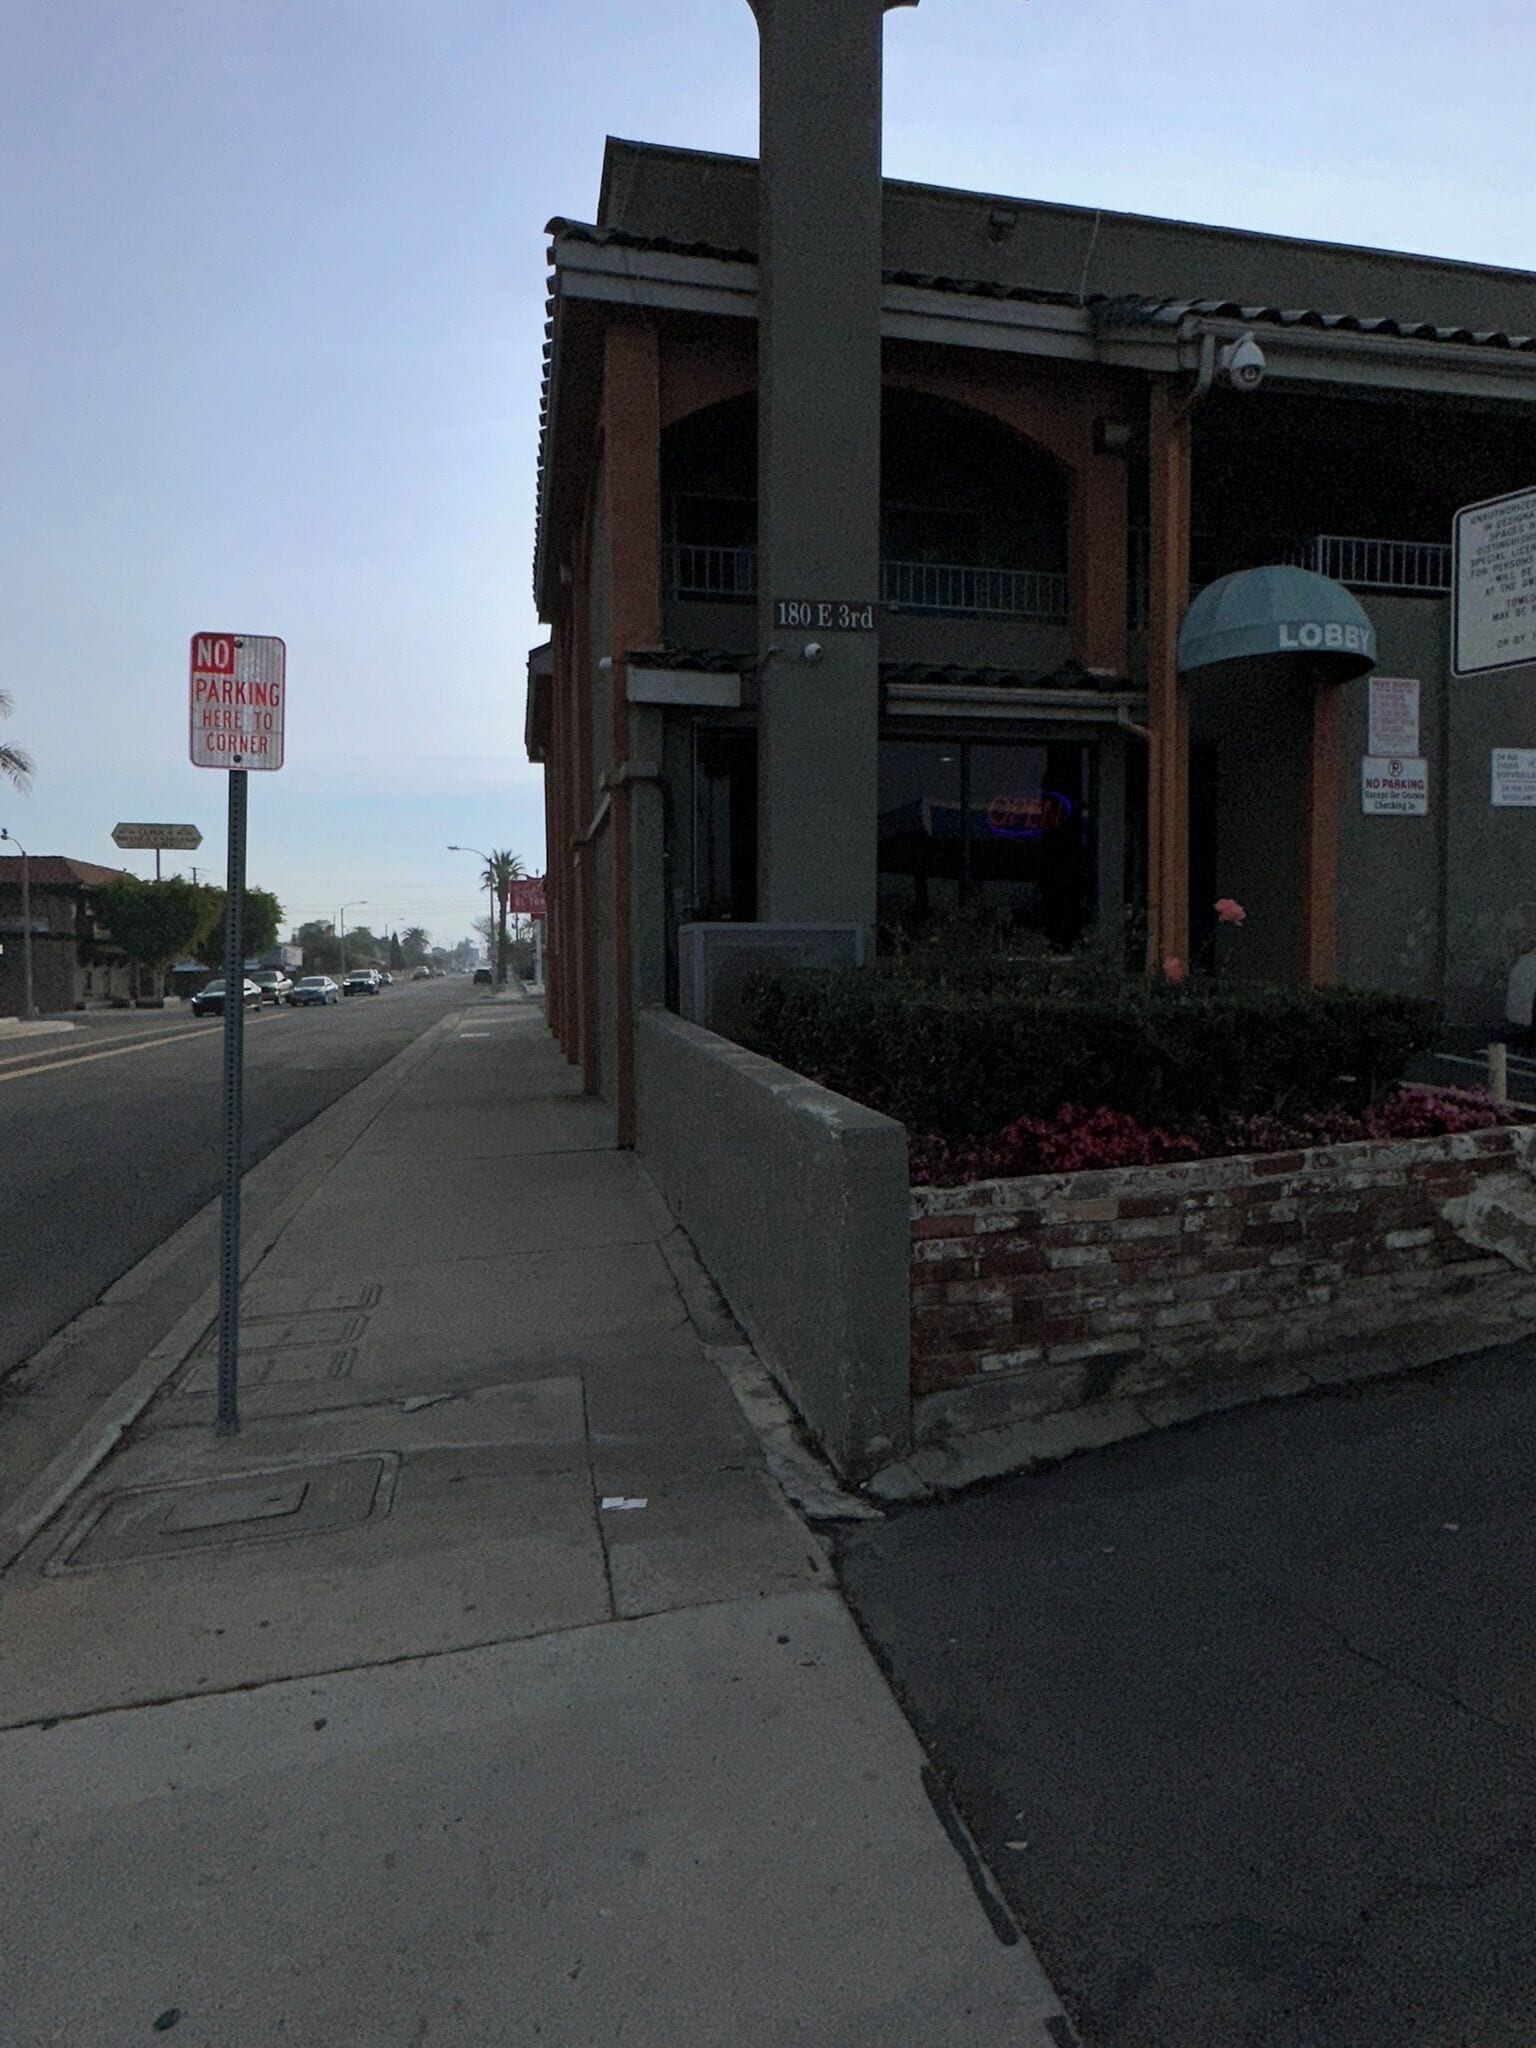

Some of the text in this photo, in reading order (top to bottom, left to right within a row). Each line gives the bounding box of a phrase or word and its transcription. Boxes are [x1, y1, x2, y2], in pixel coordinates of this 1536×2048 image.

[778, 602, 873, 629] 180 E 3rd
[1279, 622, 1370, 652] LOBBY
[197, 638, 230, 669] NO
[195, 678, 281, 708] PARKING
[203, 709, 273, 730] HERE TO
[206, 732, 268, 754] CORNER
[1365, 777, 1425, 790] NO PARKING
[987, 797, 1061, 829] OPEN
[1374, 800, 1406, 811] Checking
